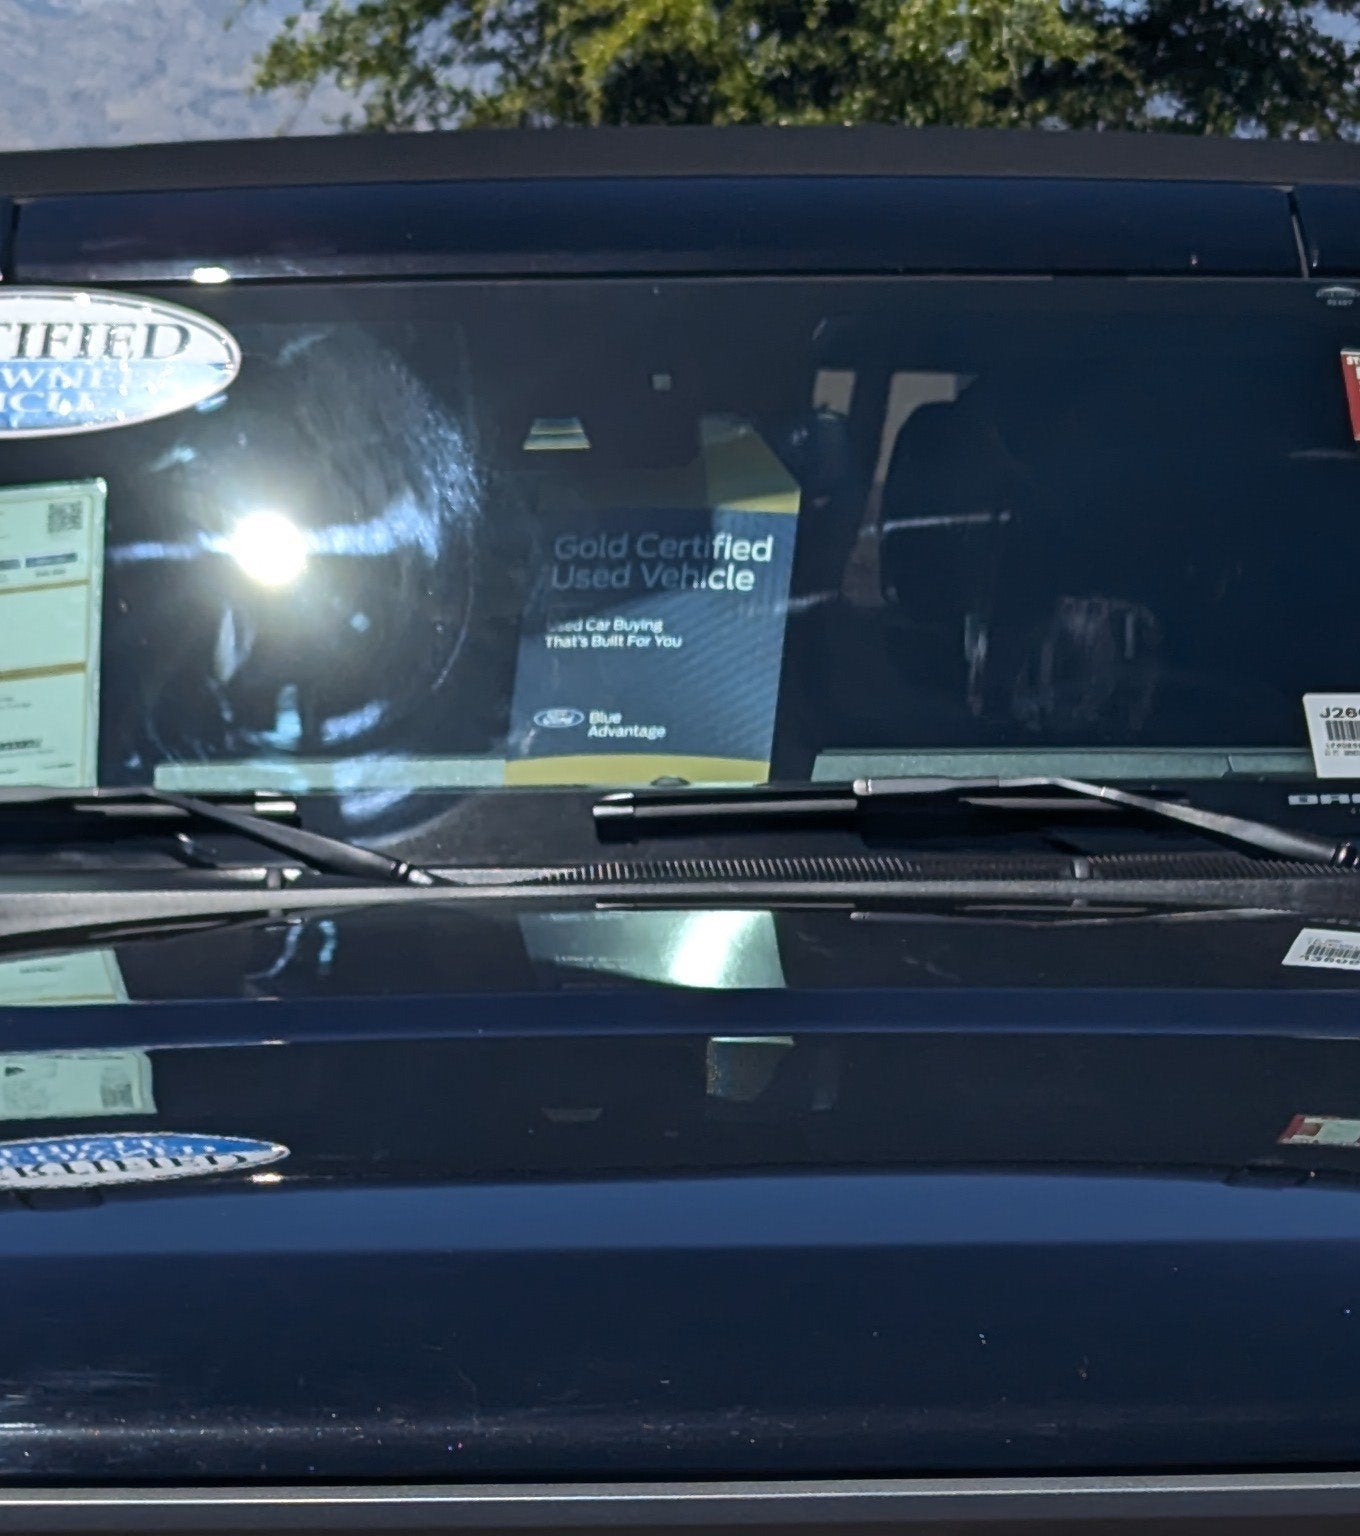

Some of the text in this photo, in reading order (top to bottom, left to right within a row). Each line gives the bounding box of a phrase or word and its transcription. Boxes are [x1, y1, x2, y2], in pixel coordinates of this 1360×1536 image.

[554, 532, 774, 562] Gold Certified
[552, 562, 756, 592] Used Vehicle
[586, 617, 611, 632] Car
[613, 616, 664, 634] Buying
[545, 634, 683, 649] That's Built For You
[588, 710, 622, 724] Blue
[587, 724, 667, 741] Advantage
